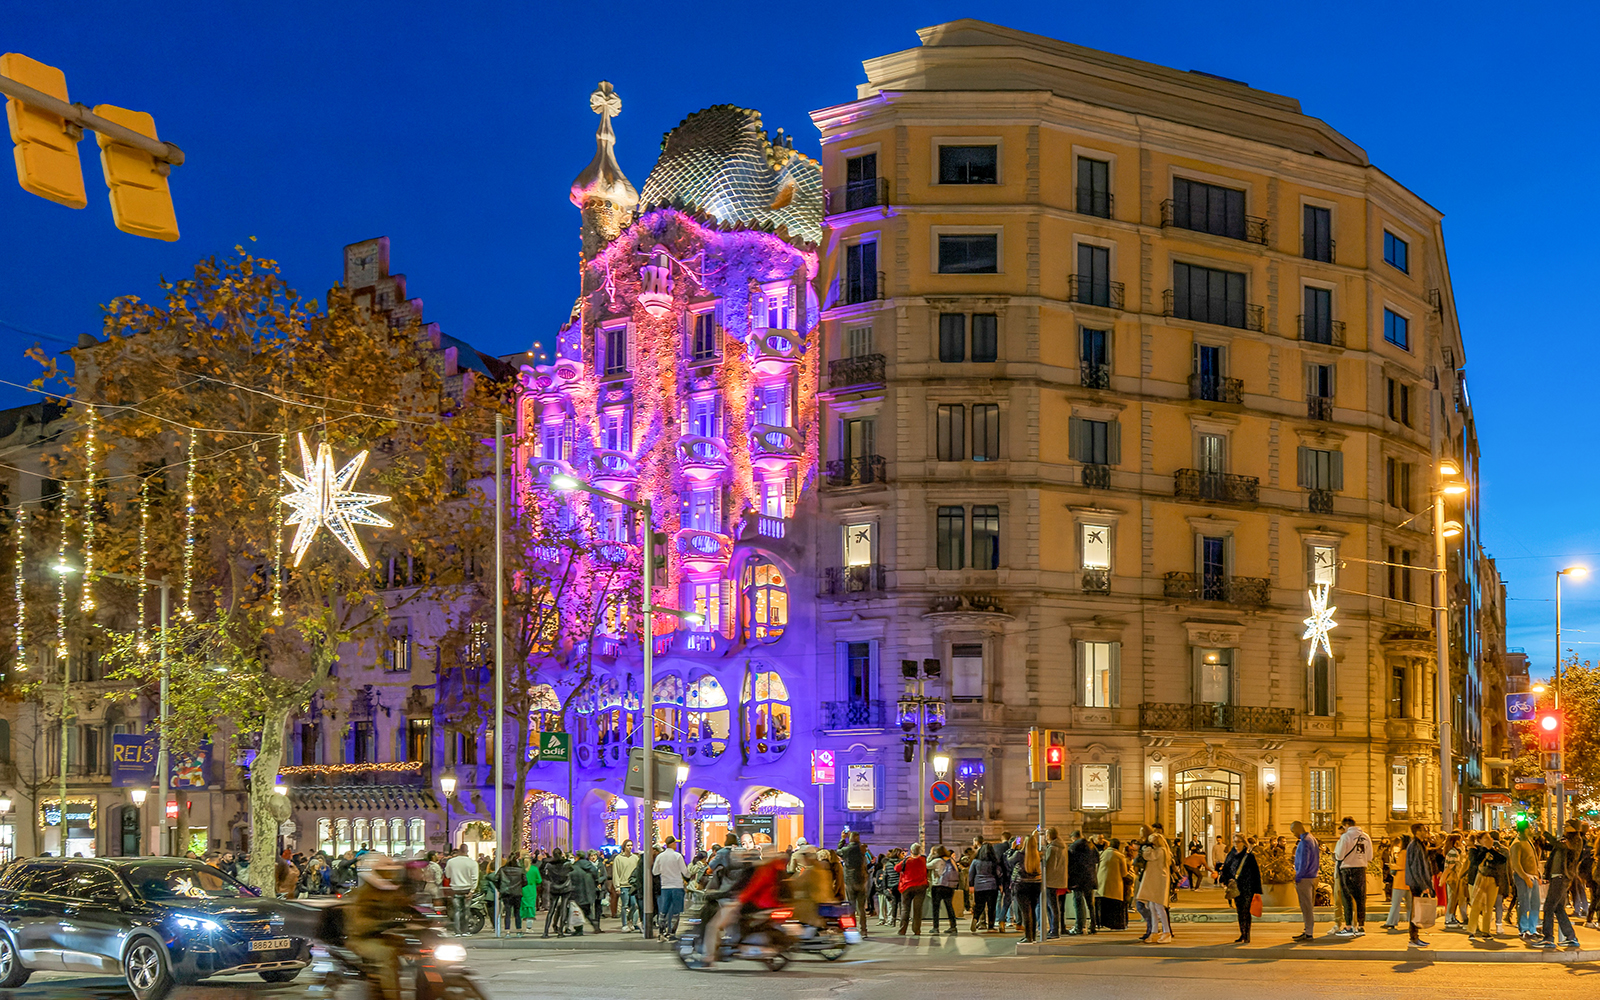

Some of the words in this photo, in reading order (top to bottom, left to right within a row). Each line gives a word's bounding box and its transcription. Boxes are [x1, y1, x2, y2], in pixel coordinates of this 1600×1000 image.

[113, 744, 154, 763] REIS
[253, 941, 273, 949] 8862
[274, 940, 289, 948] LKG
